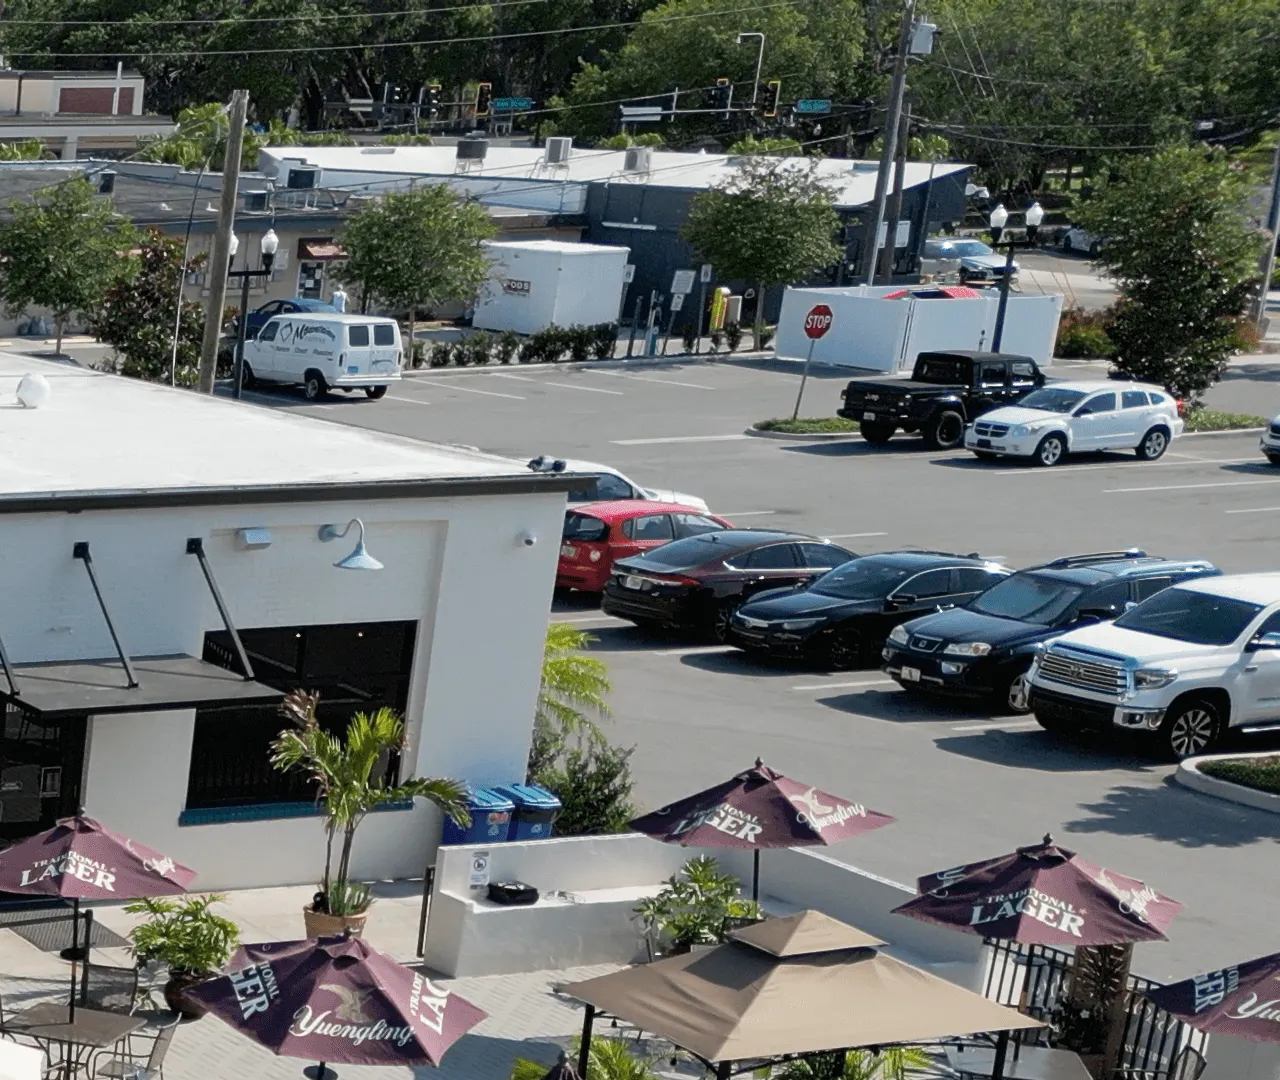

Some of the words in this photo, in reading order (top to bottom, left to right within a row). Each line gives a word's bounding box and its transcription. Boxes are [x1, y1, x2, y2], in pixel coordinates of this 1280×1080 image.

[806, 315, 832, 329] STOP
[20, 856, 116, 892] LAGER
[969, 895, 1085, 938] LAGER
[985, 887, 1075, 914] TRADITIONAL
[289, 1004, 416, 1046] Yuengling
